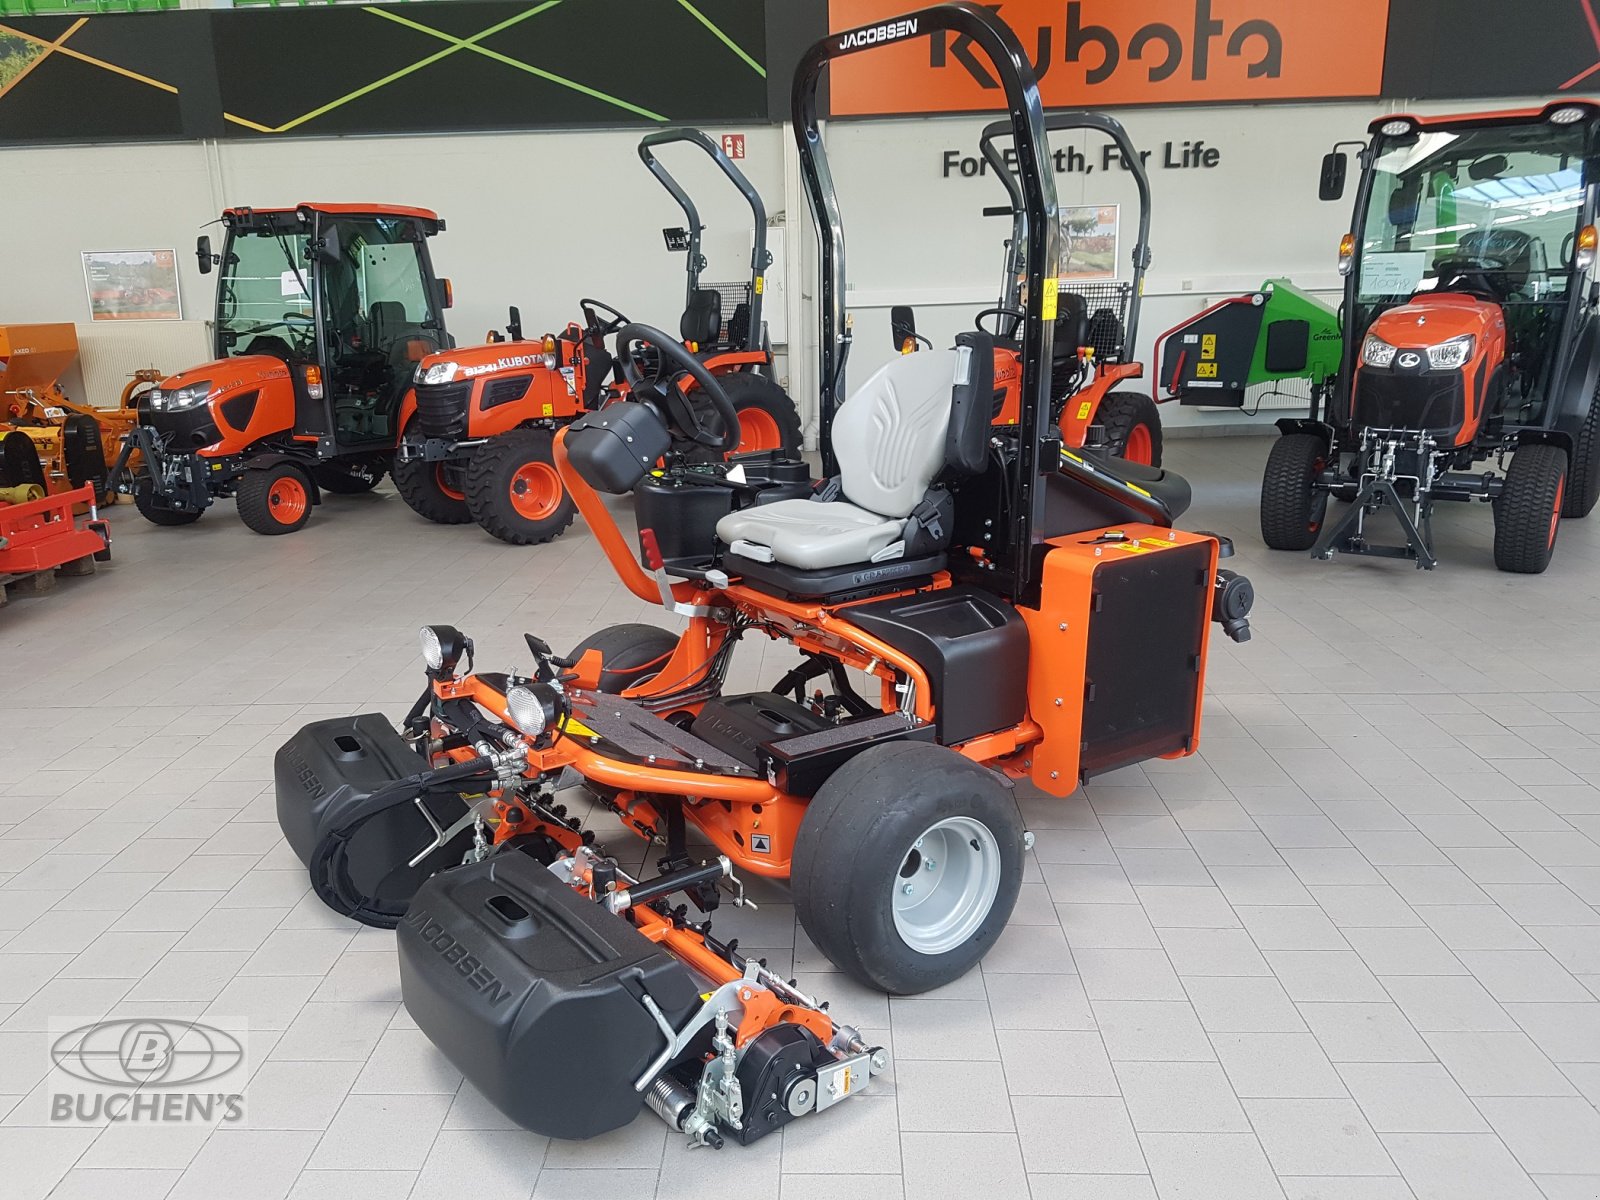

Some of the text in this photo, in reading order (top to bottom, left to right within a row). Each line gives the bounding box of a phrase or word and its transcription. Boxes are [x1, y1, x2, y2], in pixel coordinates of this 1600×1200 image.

[839, 18, 918, 50] JACOBSEN
[943, 150, 988, 178] For
[1003, 145, 1093, 175] Eth,
[1163, 140, 1220, 169] Life
[498, 353, 547, 369] KUBOTA
[403, 909, 513, 1009] JACOBSEN
